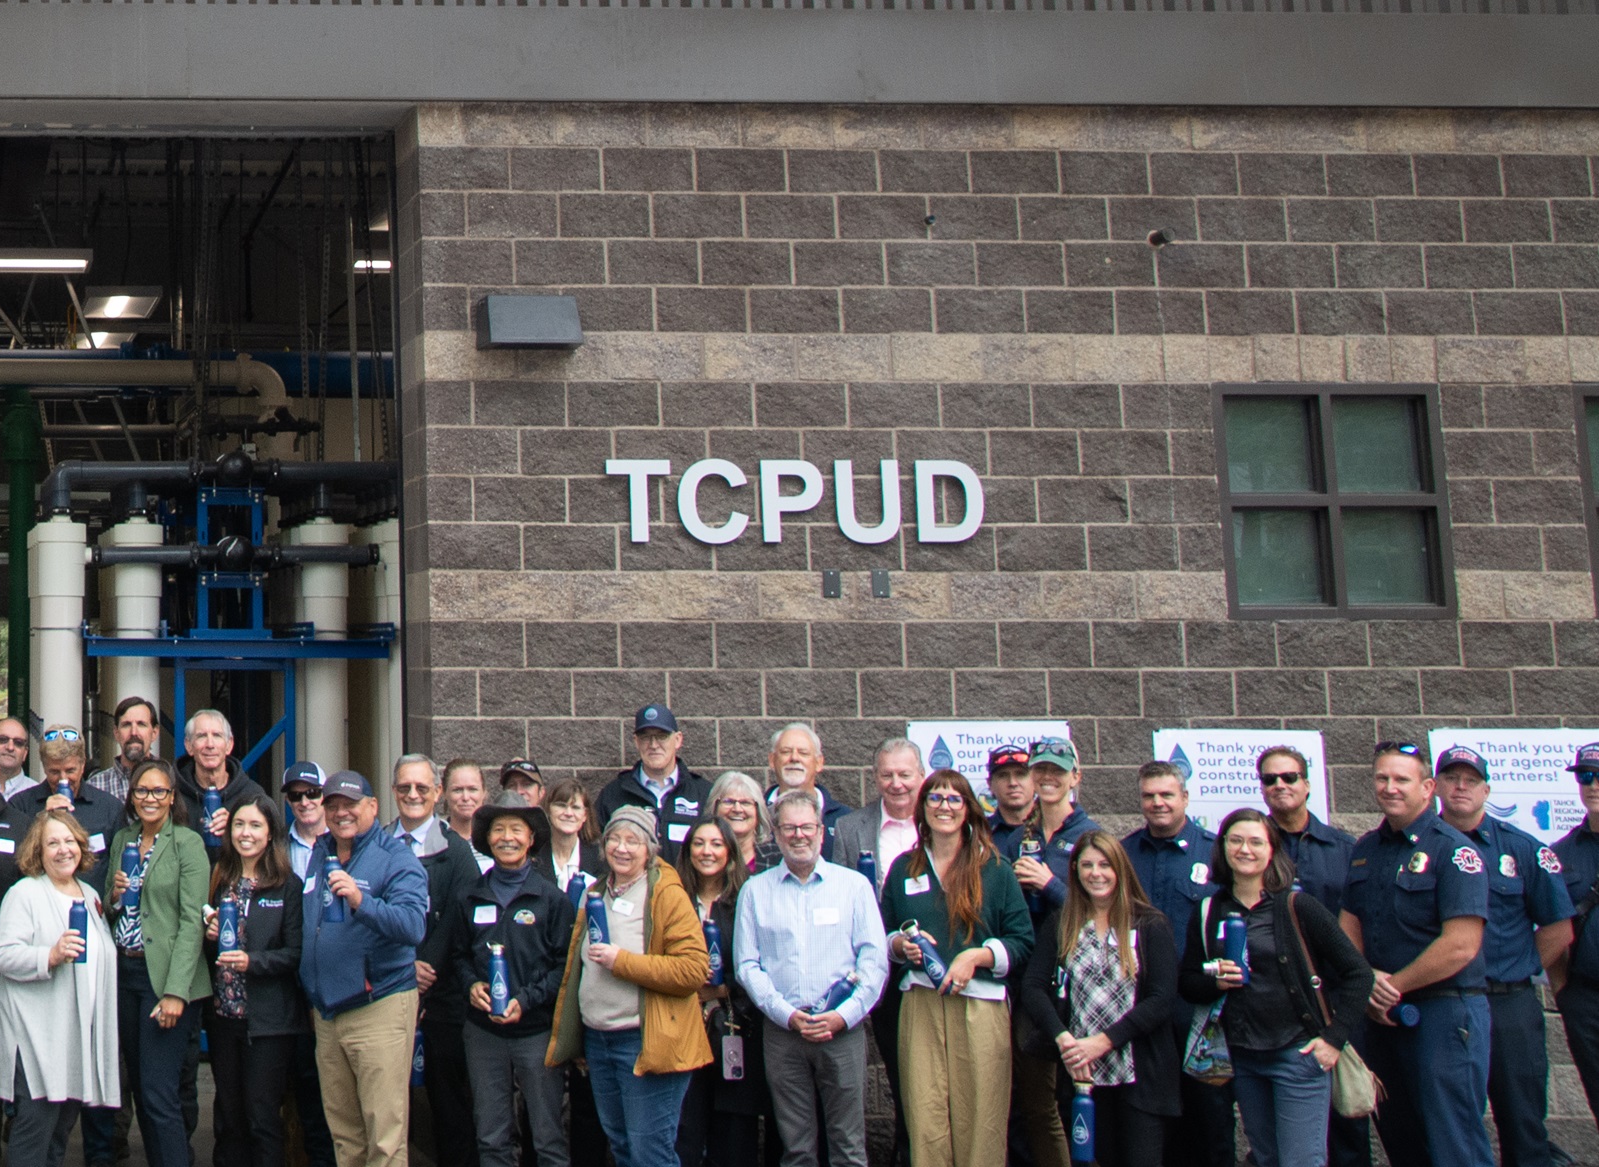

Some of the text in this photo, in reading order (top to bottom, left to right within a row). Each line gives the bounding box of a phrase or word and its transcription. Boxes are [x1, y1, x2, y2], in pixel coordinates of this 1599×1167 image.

[605, 459, 985, 544] TCPUD
[956, 733, 1004, 745] Thank
[1196, 742, 1244, 753] Thank
[1476, 742, 1528, 753] Thank
[1532, 744, 1563, 755] you
[957, 750, 982, 759] our
[1197, 758, 1223, 767] our
[1511, 758, 1573, 770] agency
[1198, 771, 1261, 781] constru
[1488, 771, 1559, 782] artners!
